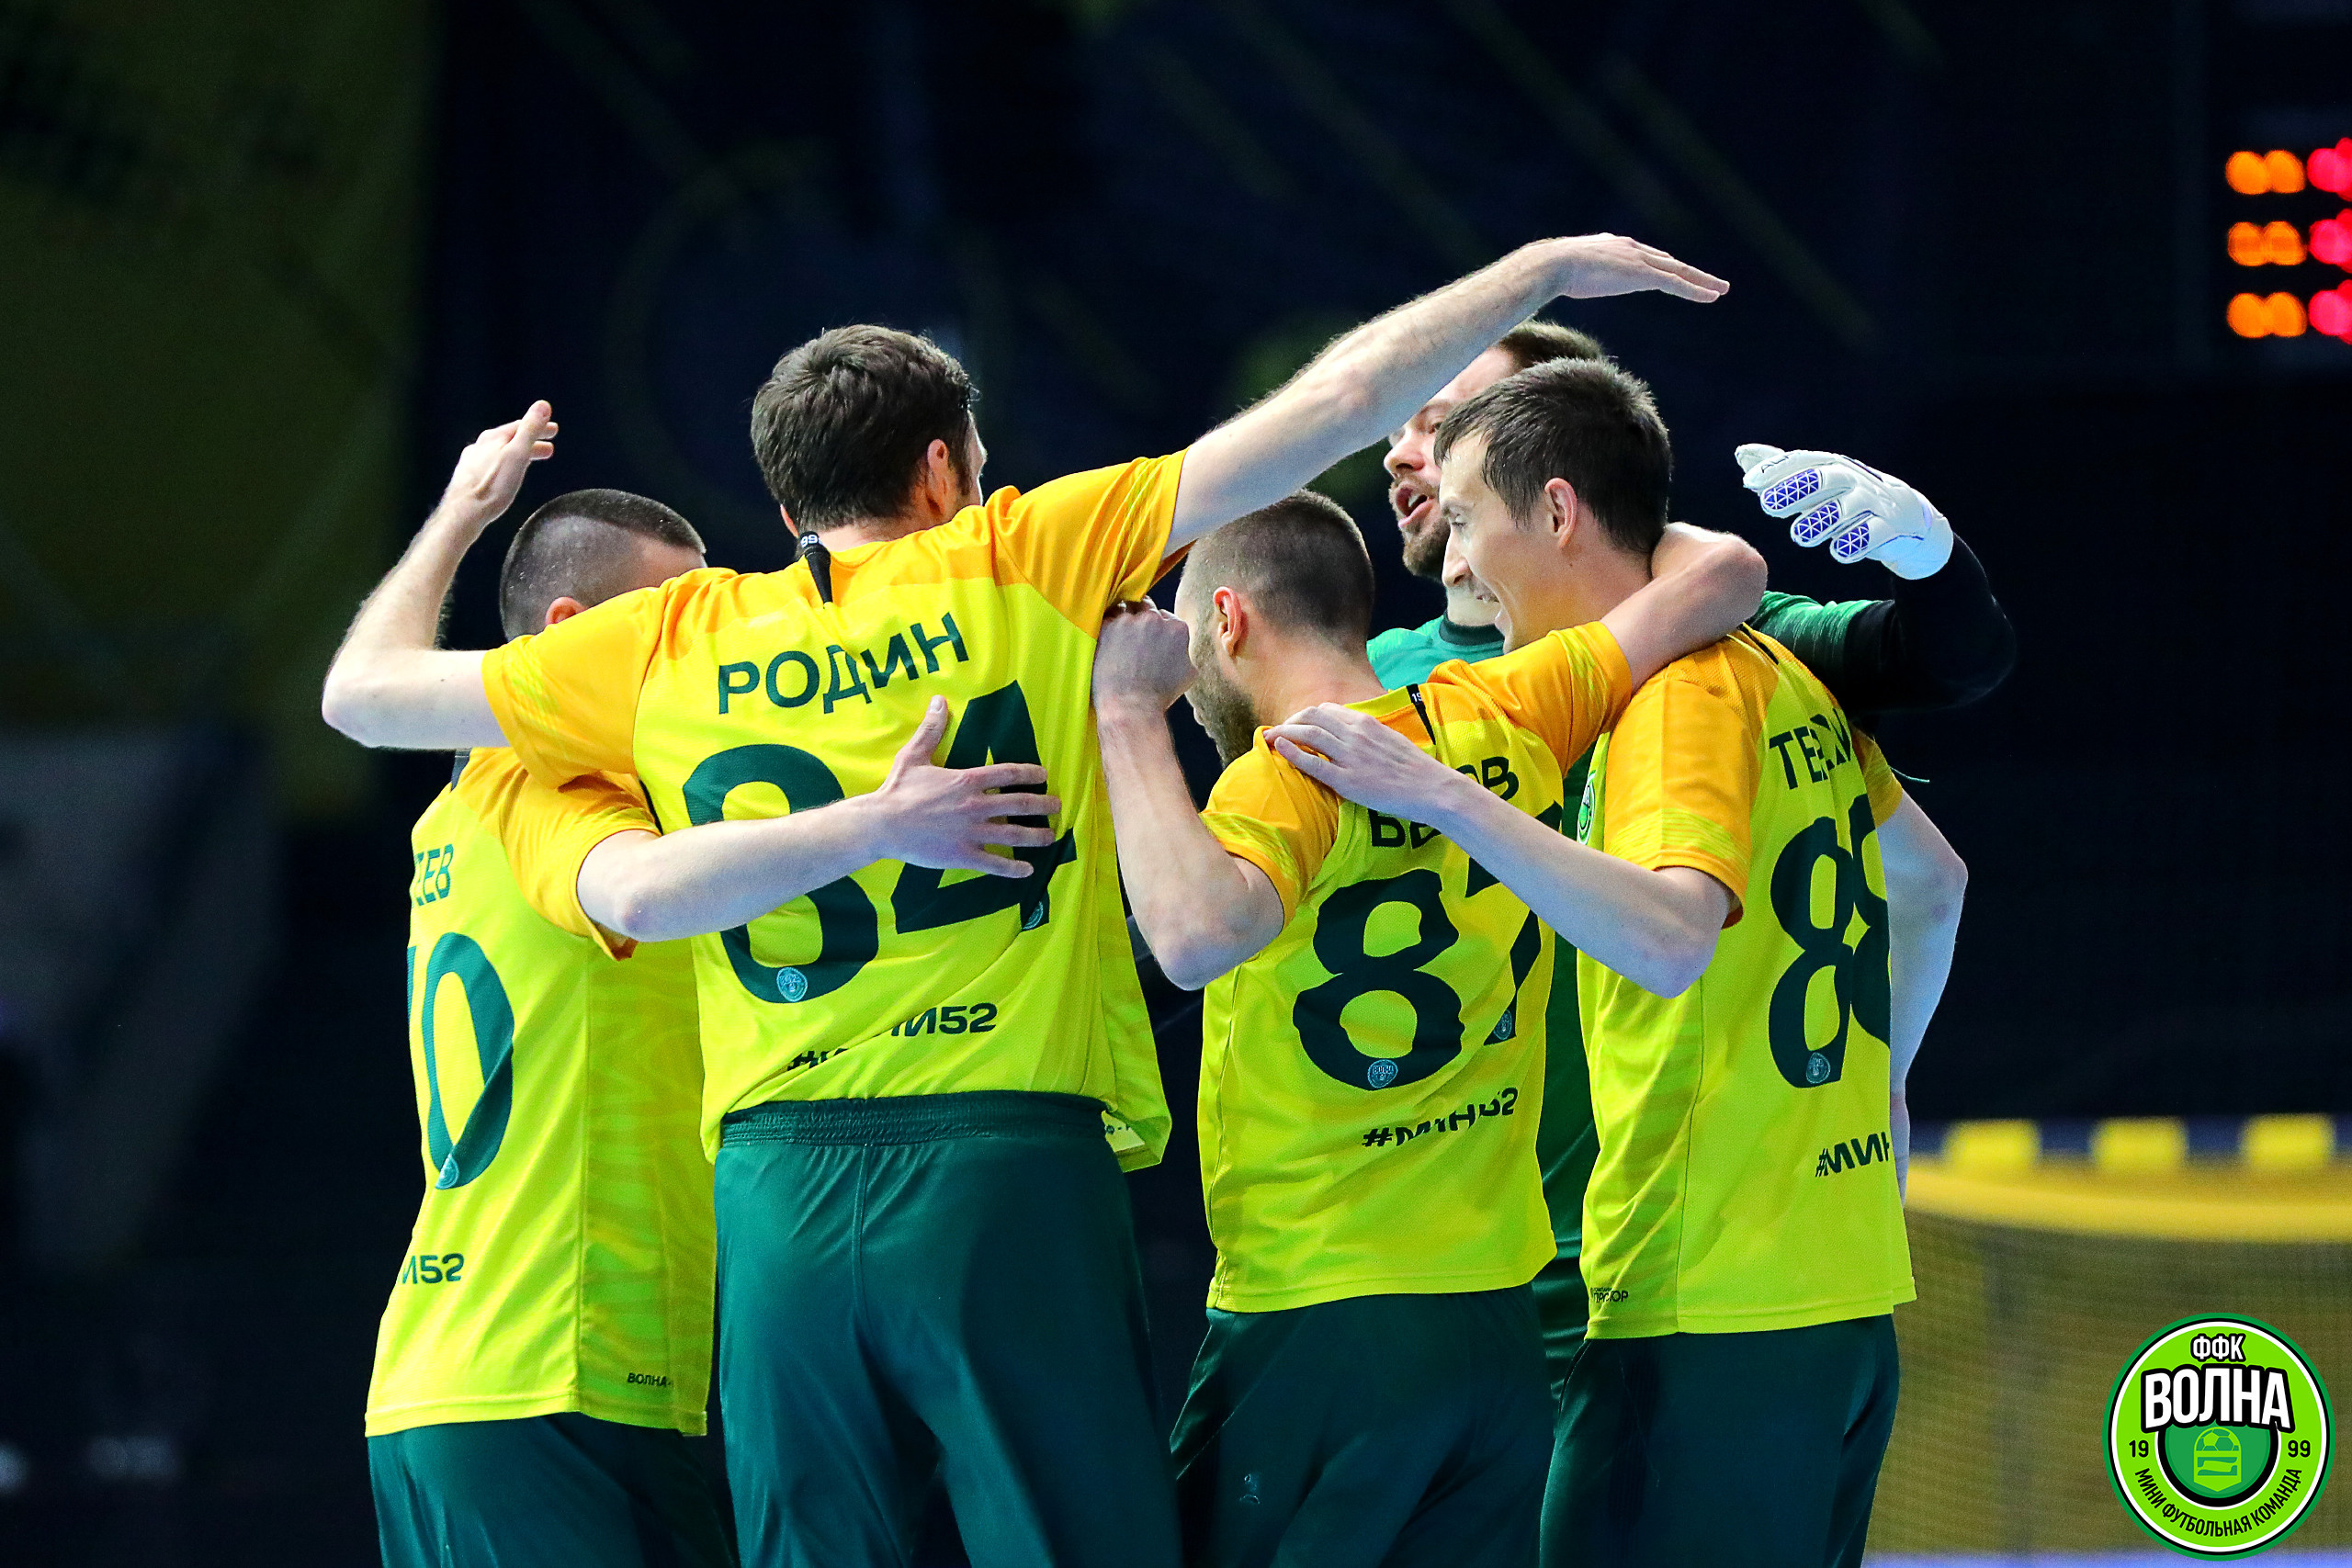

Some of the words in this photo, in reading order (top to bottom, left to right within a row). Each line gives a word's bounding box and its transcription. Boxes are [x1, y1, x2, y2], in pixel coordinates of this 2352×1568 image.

[718, 611, 969, 715] РОДИН
[682, 680, 1078, 1004] 84
[1292, 799, 1563, 1091] 87
[1768, 793, 1891, 1089] 88
